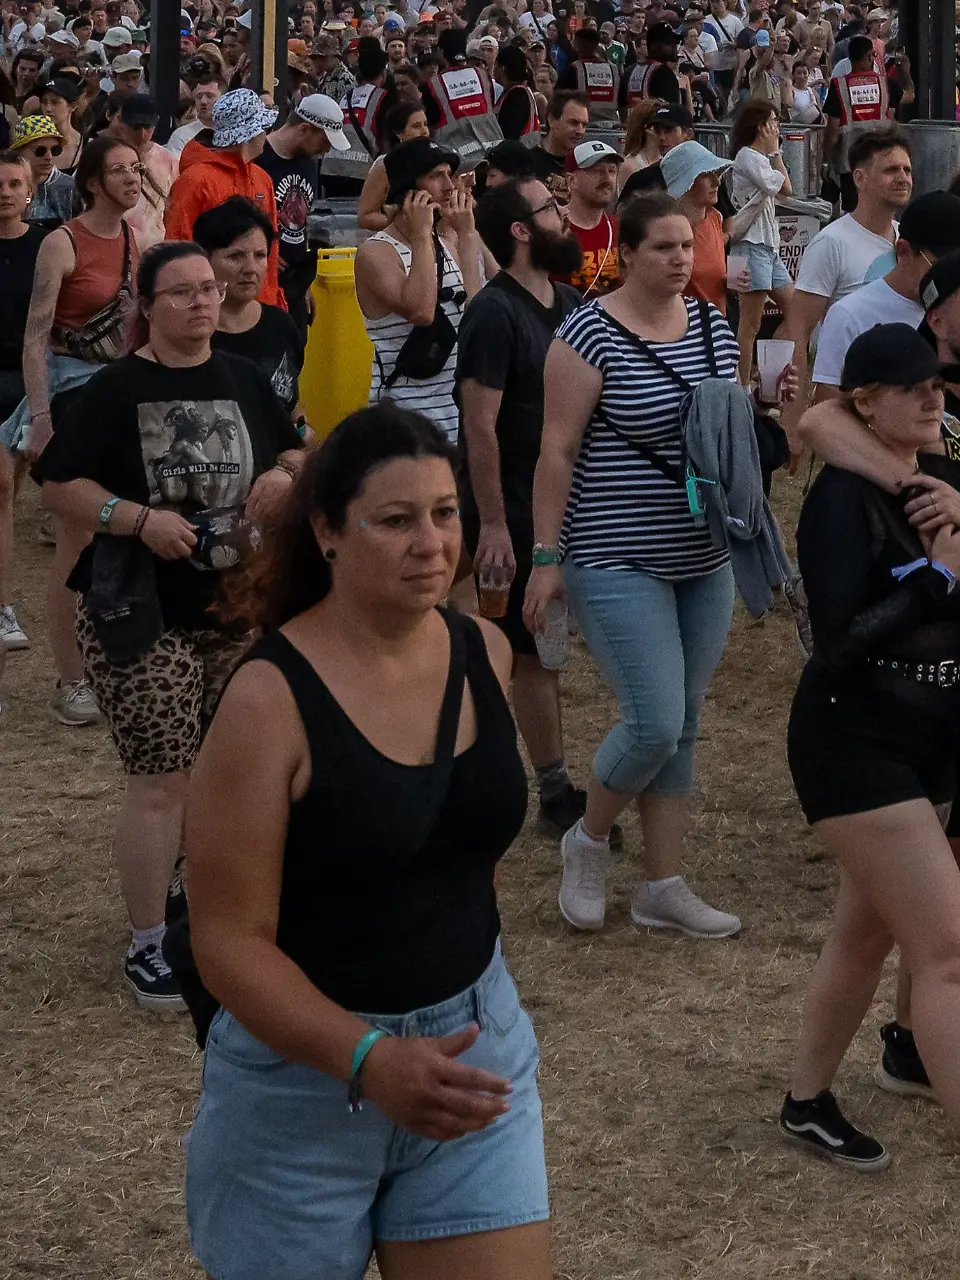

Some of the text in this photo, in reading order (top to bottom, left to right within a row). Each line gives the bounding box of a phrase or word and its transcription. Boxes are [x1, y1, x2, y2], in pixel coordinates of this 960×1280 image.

[779, 245, 807, 258] END
[781, 258, 799, 271] EIN
[162, 463, 239, 477] Girls Will Be Girls
